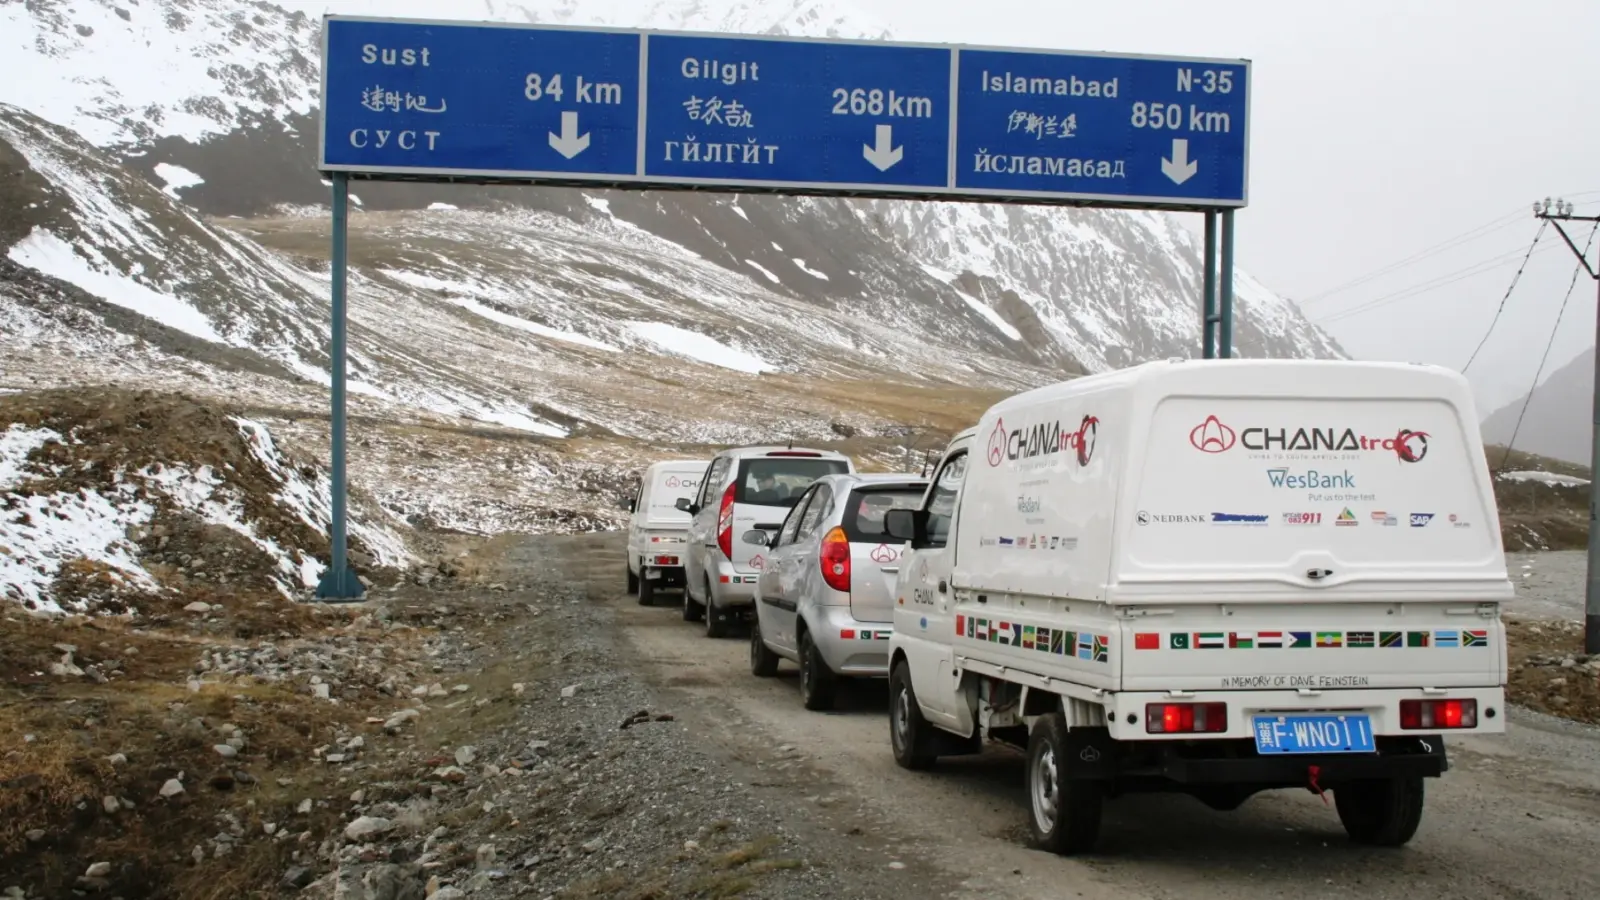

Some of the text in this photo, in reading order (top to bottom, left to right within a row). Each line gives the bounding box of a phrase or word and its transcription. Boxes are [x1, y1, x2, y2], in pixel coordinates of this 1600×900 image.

[361, 43, 430, 67] Sust
[681, 57, 759, 85] Gilgit
[1176, 68, 1234, 94] N-35
[524, 73, 622, 105] 84 km
[981, 70, 1119, 98] Islamabad
[1007, 109, 1077, 140] 伊斯兰堡
[1130, 101, 1231, 133] 850 km
[1267, 467, 1355, 489] WesBank
[1308, 493, 1322, 502] Put
[1345, 493, 1358, 501] the
[1360, 493, 1375, 502] test
[1152, 514, 1206, 523] NEDBANK
[1302, 512, 1322, 524] 911
[1410, 514, 1431, 525] SAP
[1221, 675, 1369, 687] IN MEMORY OF DAVE FEINSTEIN
